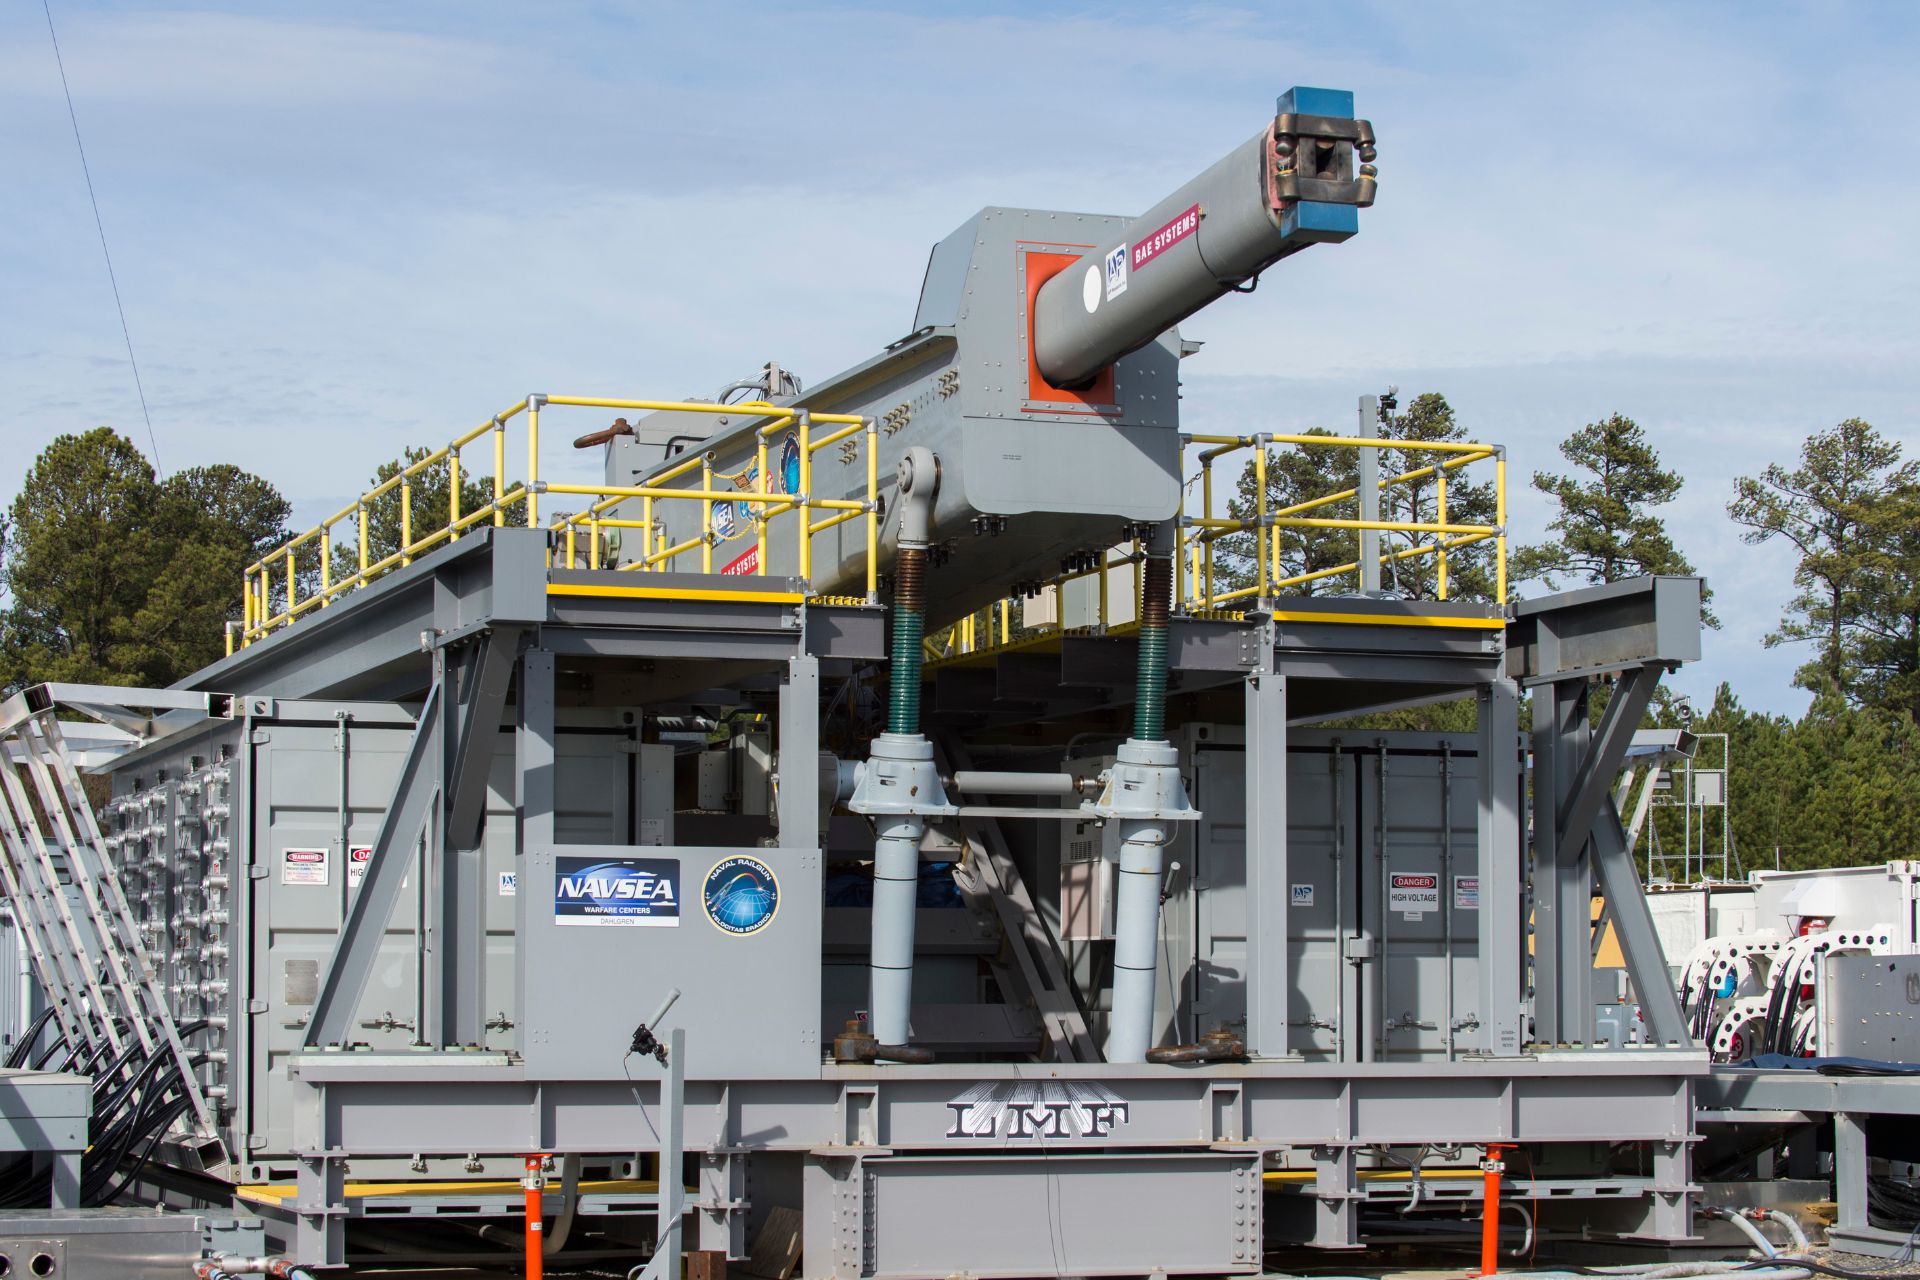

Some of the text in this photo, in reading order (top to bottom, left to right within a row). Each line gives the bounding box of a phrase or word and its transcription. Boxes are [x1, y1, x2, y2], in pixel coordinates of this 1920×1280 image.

[1135, 212, 1196, 264] BAE SYSTEMS
[350, 868, 364, 876] HIG
[710, 859, 772, 881] NAVAL RAILGUN
[557, 877, 674, 899] NAVSEA
[1391, 894, 1437, 902] HIGH VOLTAGE
[584, 906, 617, 914] WARFARE
[711, 912, 771, 933] VELOCITAS ERADICO
[946, 1102, 1129, 1138] LMF
